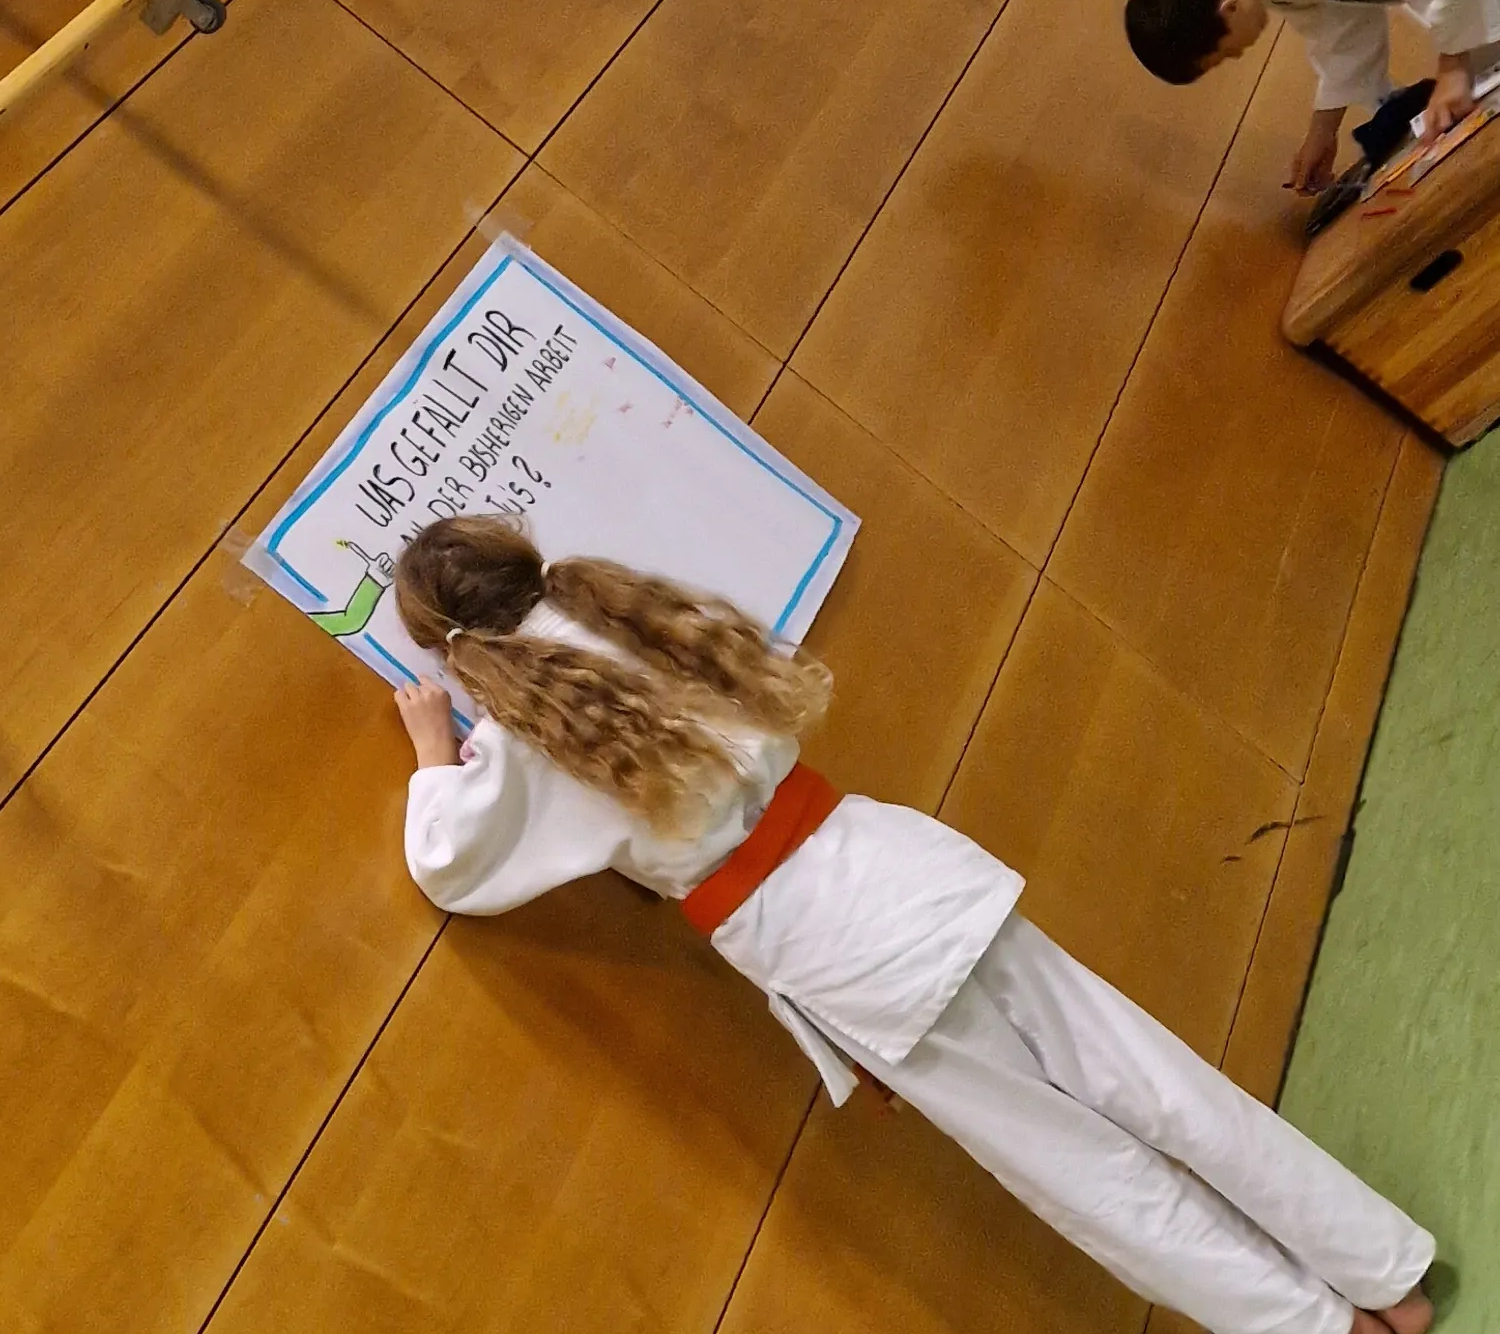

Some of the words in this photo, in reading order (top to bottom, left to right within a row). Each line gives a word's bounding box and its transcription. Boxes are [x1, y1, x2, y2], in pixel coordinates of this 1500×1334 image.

[355, 464, 415, 527] WAS
[468, 310, 537, 372] DIR
[427, 476, 474, 518] DER
[459, 383, 534, 482] BISHERIGEN
[525, 324, 577, 392] ARBEIT
